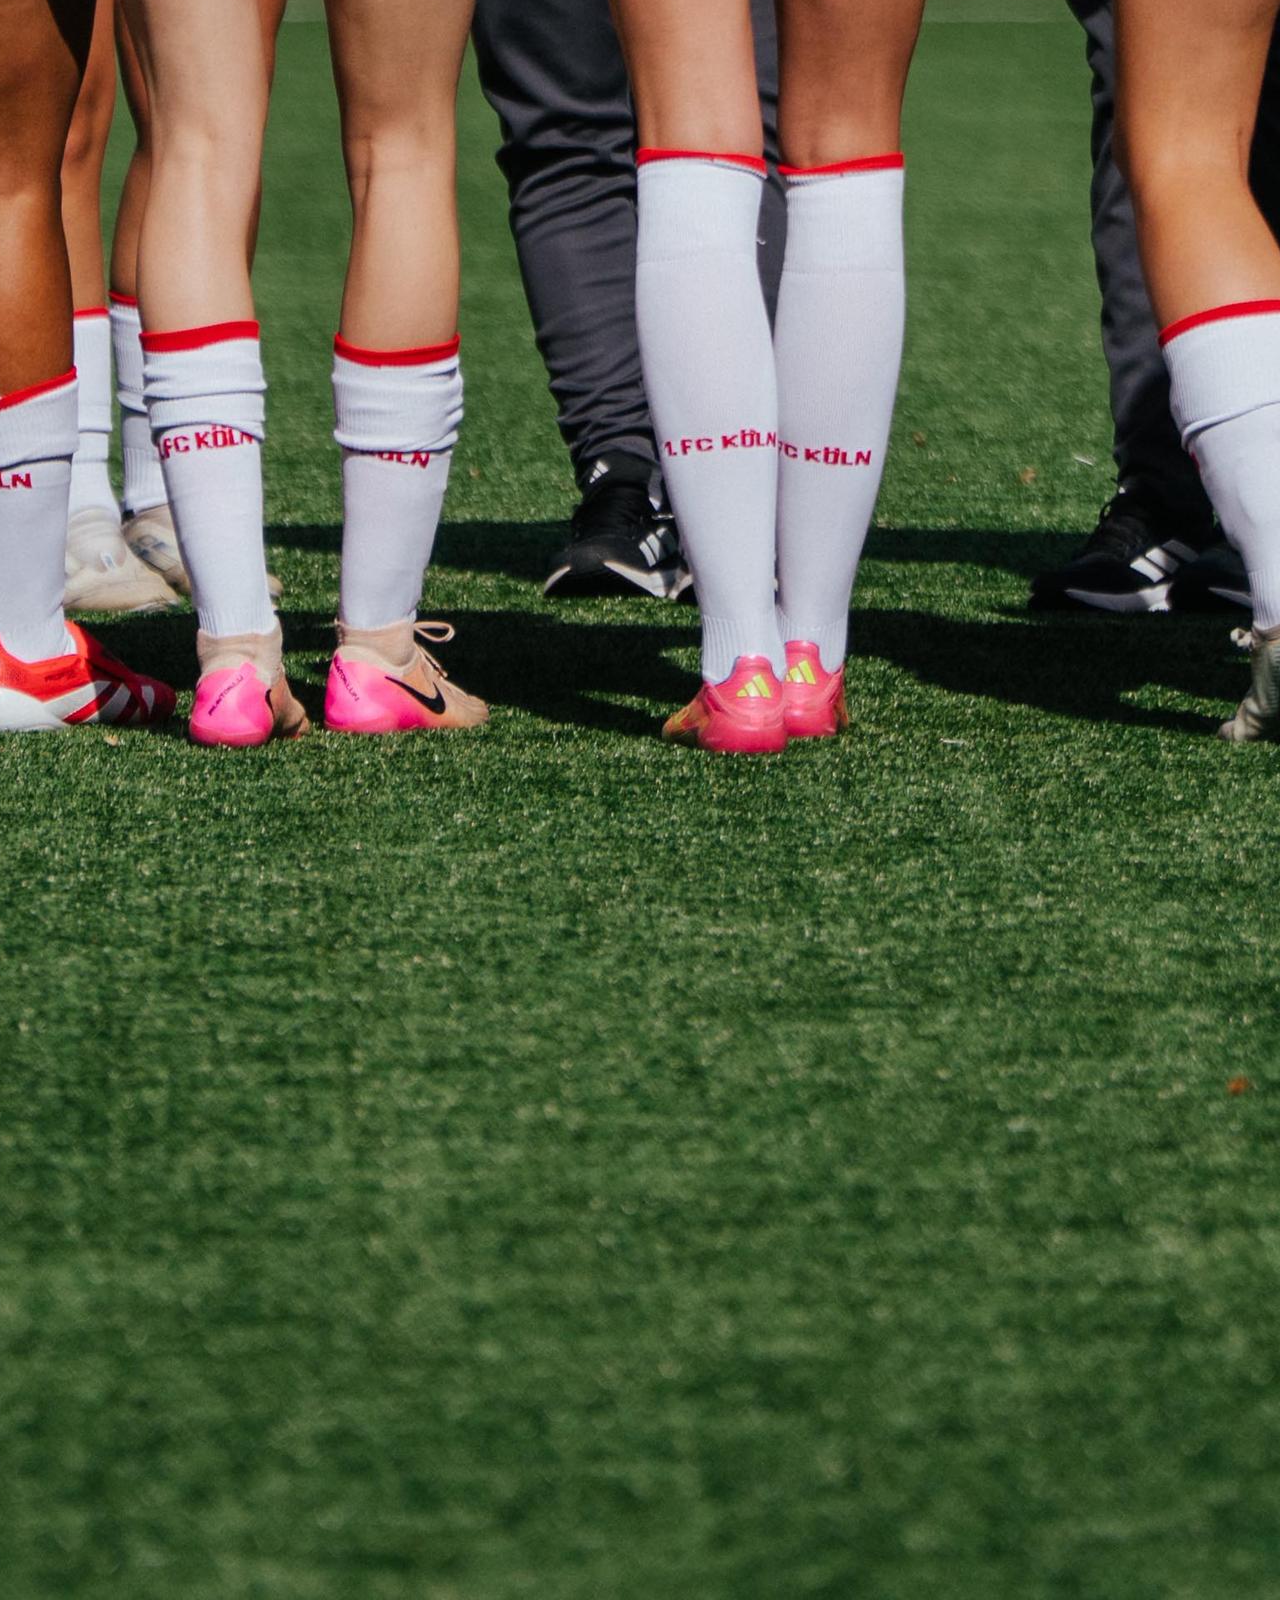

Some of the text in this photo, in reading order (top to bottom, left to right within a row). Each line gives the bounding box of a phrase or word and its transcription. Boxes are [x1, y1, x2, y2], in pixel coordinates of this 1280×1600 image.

[680, 437, 714, 456] FC
[721, 428, 777, 450] KÖLN
[804, 446, 872, 467] KÖLN
